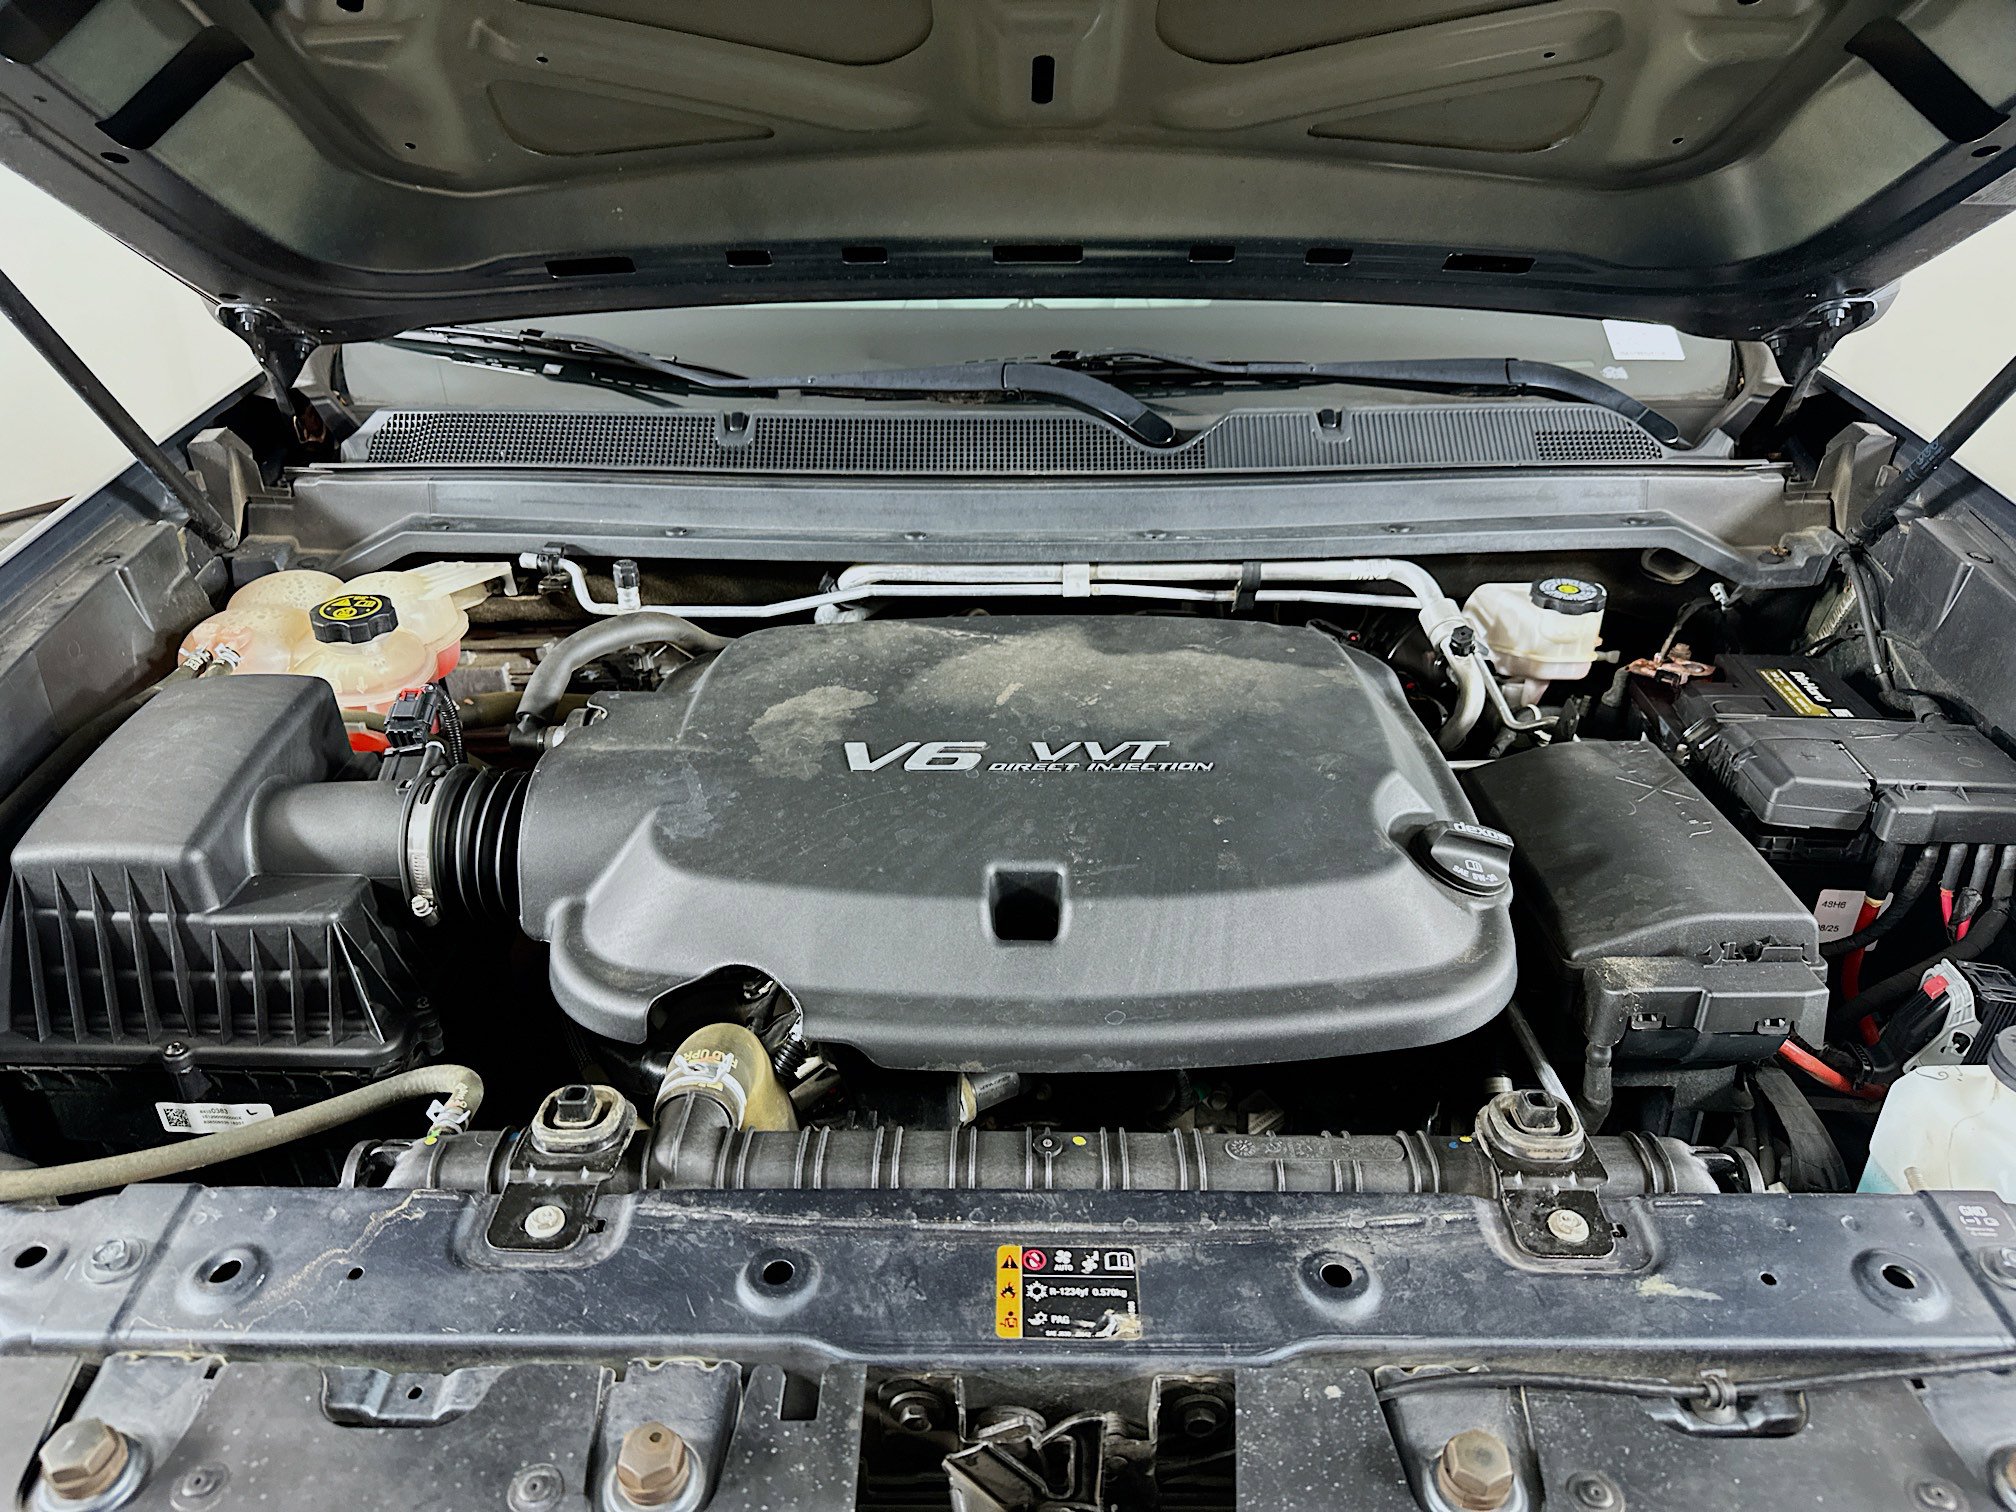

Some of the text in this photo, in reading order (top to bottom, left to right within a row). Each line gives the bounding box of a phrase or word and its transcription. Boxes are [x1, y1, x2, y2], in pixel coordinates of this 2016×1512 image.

[844, 740, 1171, 773] V6 VVT
[987, 761, 1214, 773] DIRECT INJECTION
[1453, 821, 1509, 843] dexos
[1452, 864, 1470, 878] SAE
[1053, 1264, 1074, 1272] AUTO
[1049, 1287, 1089, 1298] R-1234yf
[1050, 1314, 1071, 1325] PAG
